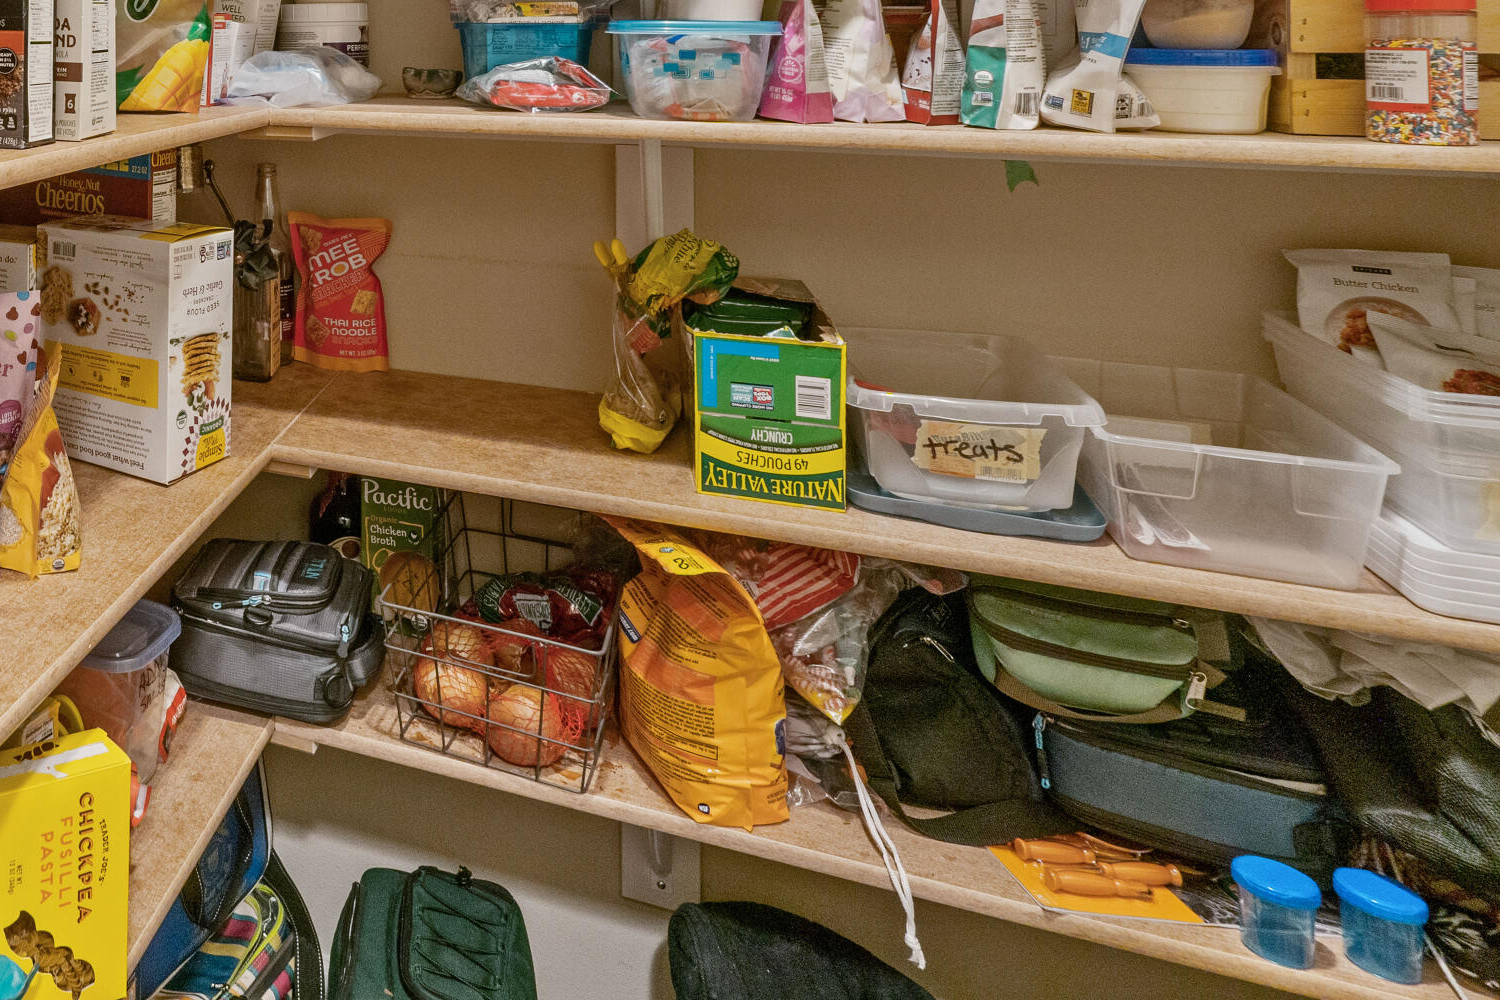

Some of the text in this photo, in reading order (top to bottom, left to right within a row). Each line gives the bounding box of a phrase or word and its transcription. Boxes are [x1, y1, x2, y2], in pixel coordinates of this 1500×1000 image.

[222, 4, 242, 15] WELL
[67, 99, 74, 108] 6
[59, 175, 101, 192] Honey Nut
[35, 181, 105, 216] Cheerios
[308, 237, 360, 271] MEE
[182, 280, 223, 298] Garlic Herb
[1332, 277, 1420, 294] Butter Chicken
[186, 300, 220, 316] SEED FLOUR
[323, 317, 377, 328] THAI RICE
[331, 327, 377, 337] NOODLE
[199, 419, 222, 436] ORGANIC
[750, 428, 793, 445] CRUNCHY
[79, 444, 113, 461] good food
[198, 442, 223, 463] Simple
[922, 437, 1024, 463] treats
[736, 450, 809, 471] 49 POUCHES
[704, 461, 844, 503] NATURE VALLEY
[361, 478, 432, 511] Pacific
[370, 514, 398, 525] Organic
[369, 524, 407, 537] Chicken
[370, 535, 397, 547] Broth
[100, 818, 109, 853] TRADER
[58, 815, 74, 908] FUSILLI
[77, 791, 95, 924] CHICKPEA
[40, 831, 54, 905] PASTA
